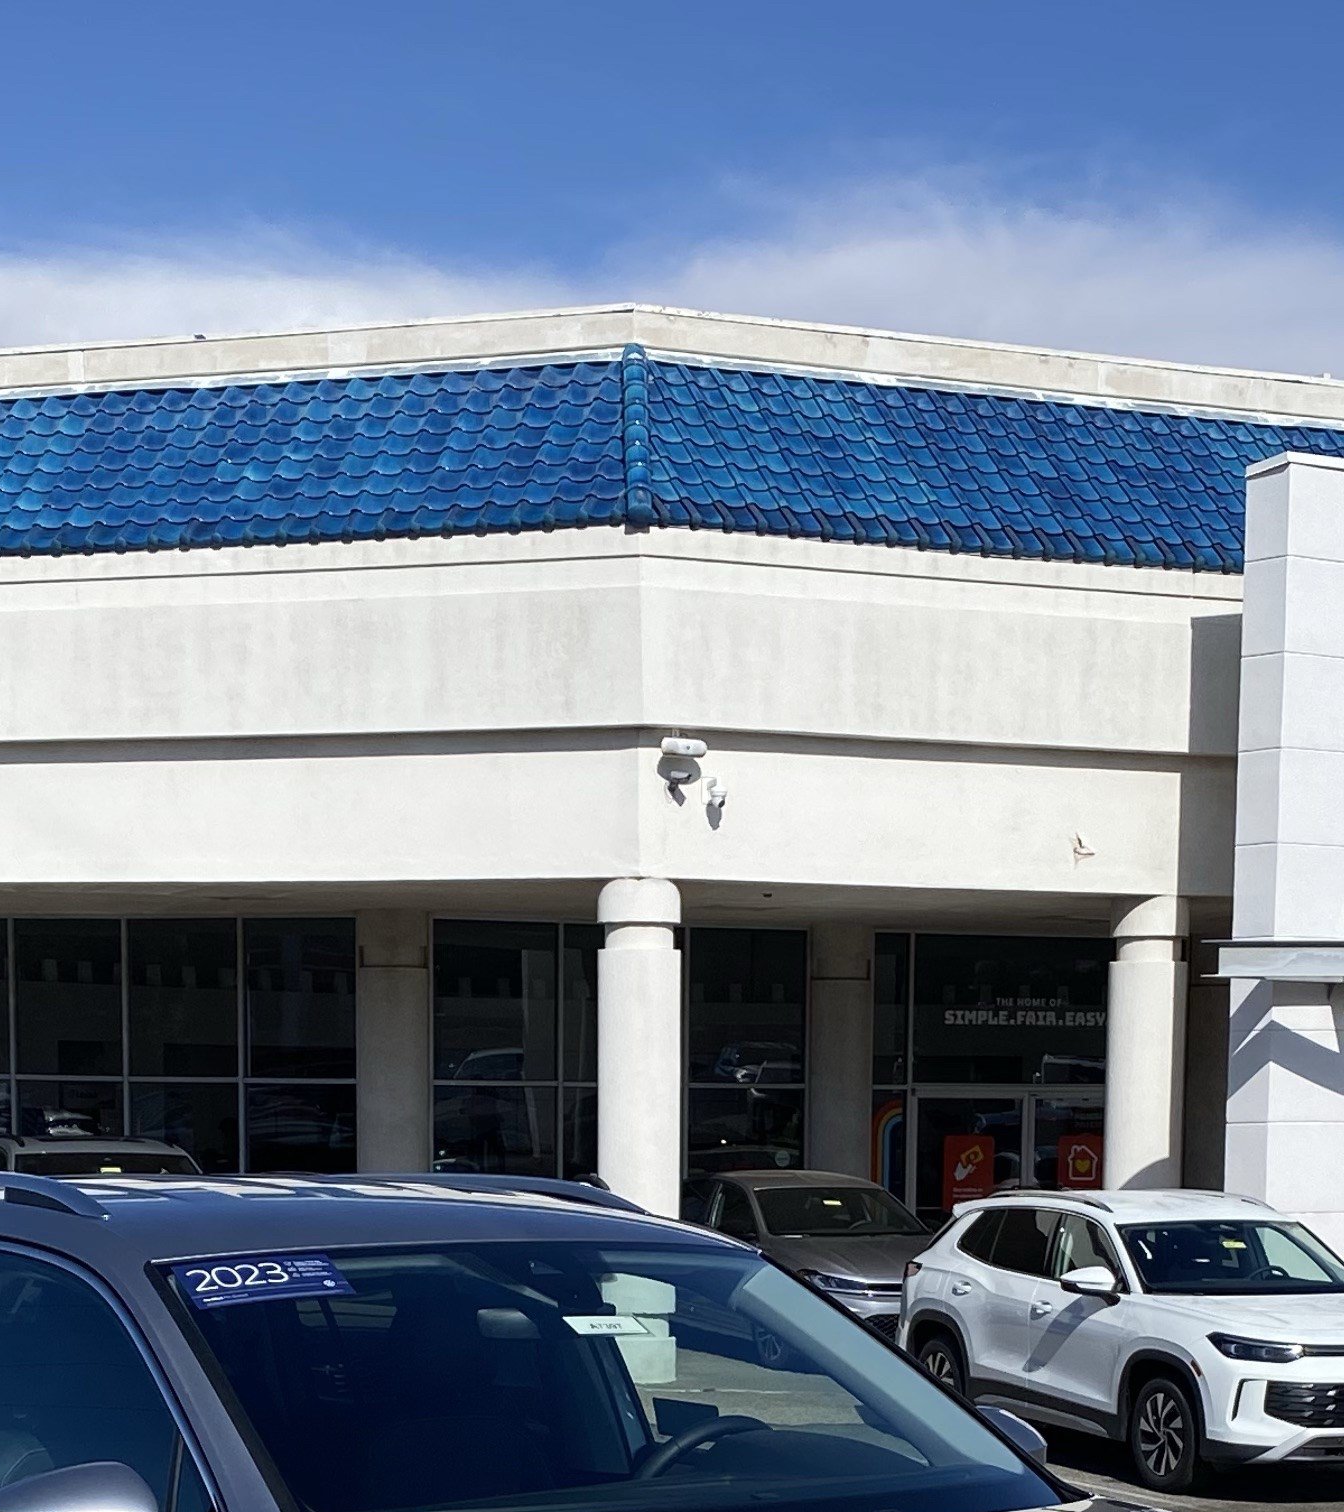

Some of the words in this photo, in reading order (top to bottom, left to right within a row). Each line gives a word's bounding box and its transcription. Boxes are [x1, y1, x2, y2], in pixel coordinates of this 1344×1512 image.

[996, 997, 1013, 1007] THE
[1016, 997, 1046, 1007] HOME
[1049, 997, 1062, 1007] OF
[185, 1262, 289, 1292] 2023
